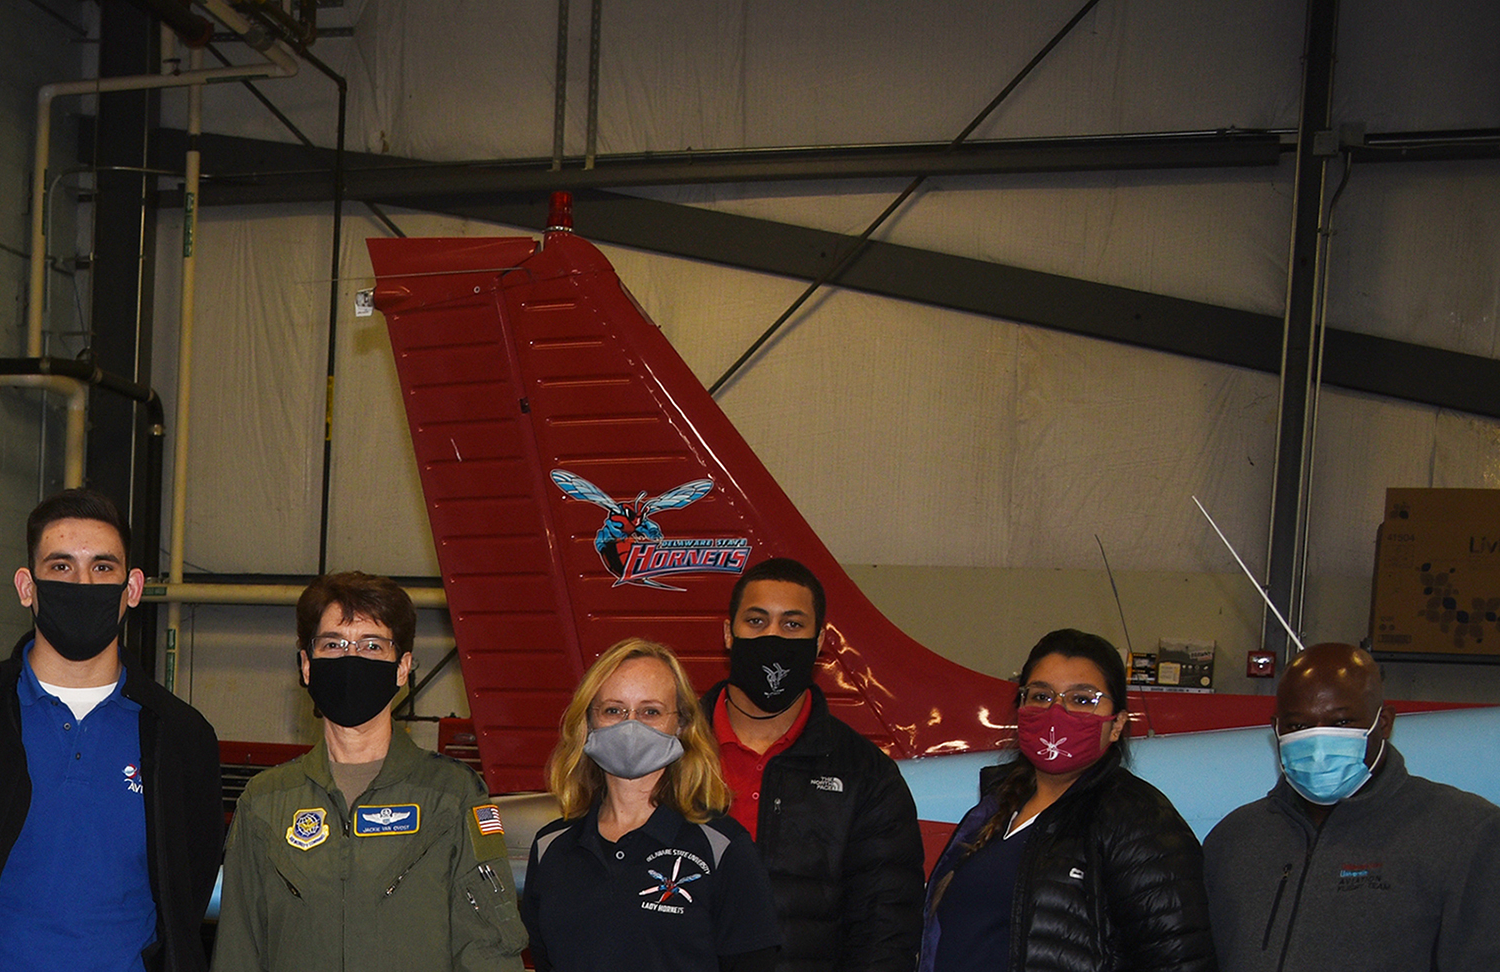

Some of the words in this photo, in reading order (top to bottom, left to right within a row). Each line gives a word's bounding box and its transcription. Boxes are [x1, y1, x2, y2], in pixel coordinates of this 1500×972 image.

[661, 538, 714, 548] DELAWARE
[715, 538, 748, 547] STATE
[645, 848, 672, 862] DELAWARE
[672, 848, 689, 858] STATE
[641, 901, 658, 911] LADY
[657, 903, 685, 915] HORNETS
